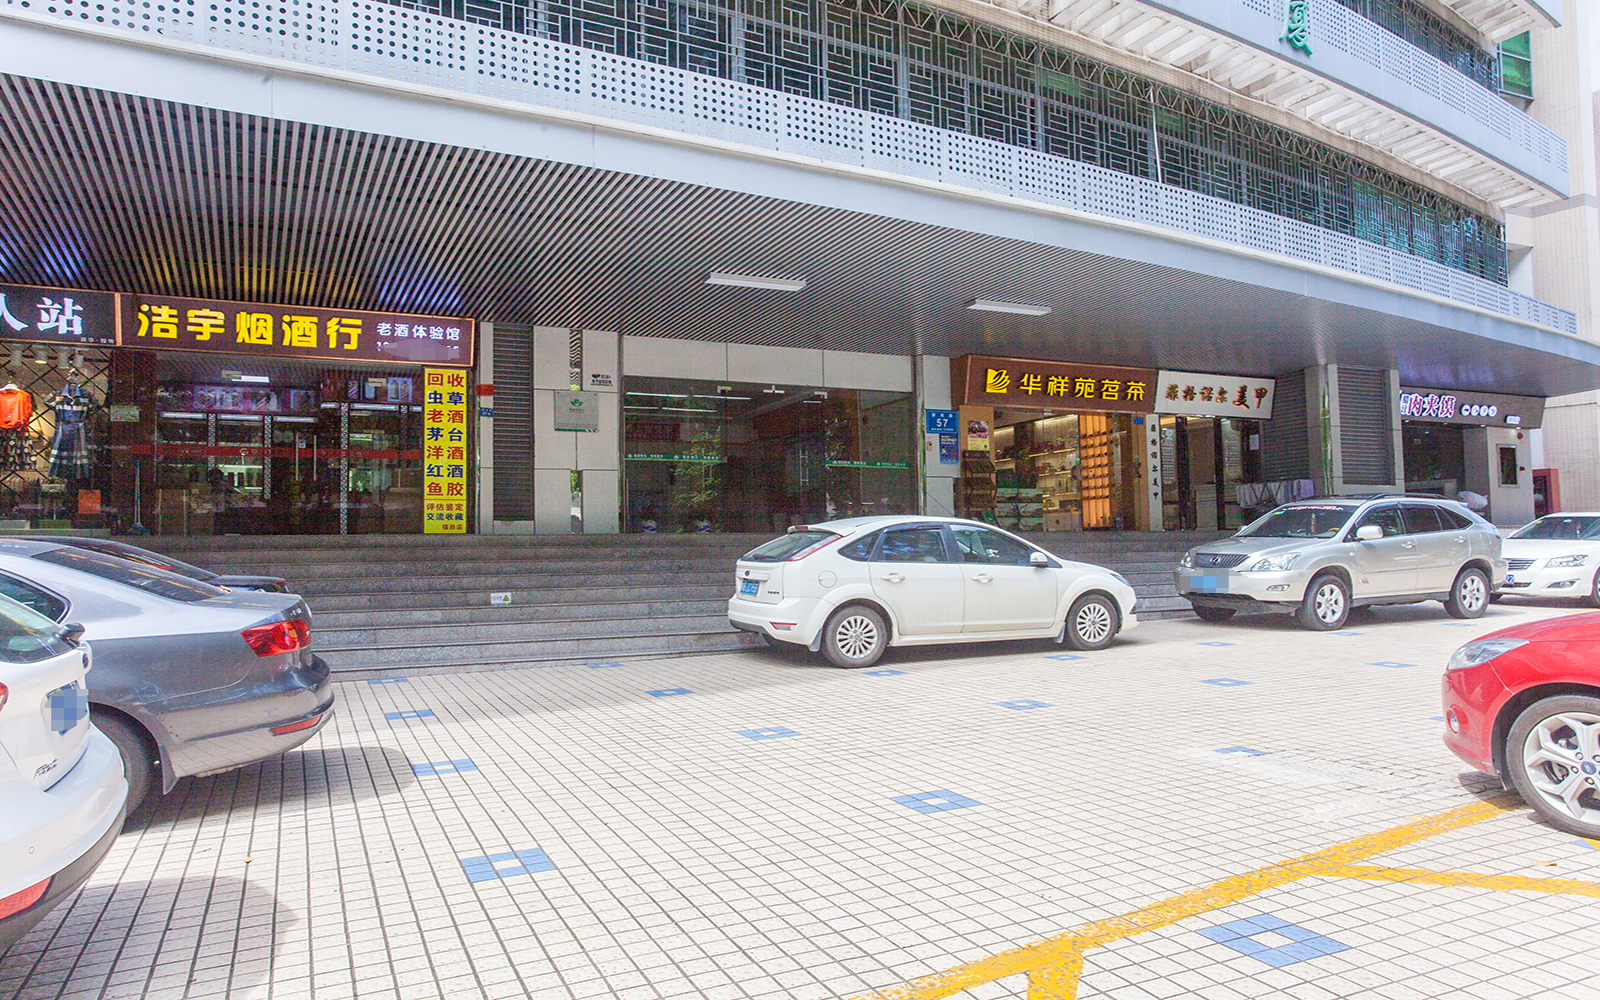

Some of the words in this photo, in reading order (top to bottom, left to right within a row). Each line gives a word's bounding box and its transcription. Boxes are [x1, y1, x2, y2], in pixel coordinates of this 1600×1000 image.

[1279, 0, 1313, 55] 厦
[137, 303, 362, 350] 浩宇烟酒行
[376, 322, 461, 341] 老酒体验馆
[427, 373, 464, 388] 回收
[1020, 373, 1147, 401] 华祥苑茗茶
[427, 391, 464, 406] 虫草
[426, 408, 464, 424] 老酒
[936, 418, 949, 428] 57
[426, 427, 464, 442] 茅台
[426, 446, 464, 460] 洋酒
[426, 464, 464, 479] 红酒
[427, 482, 464, 497] 鱼胶
